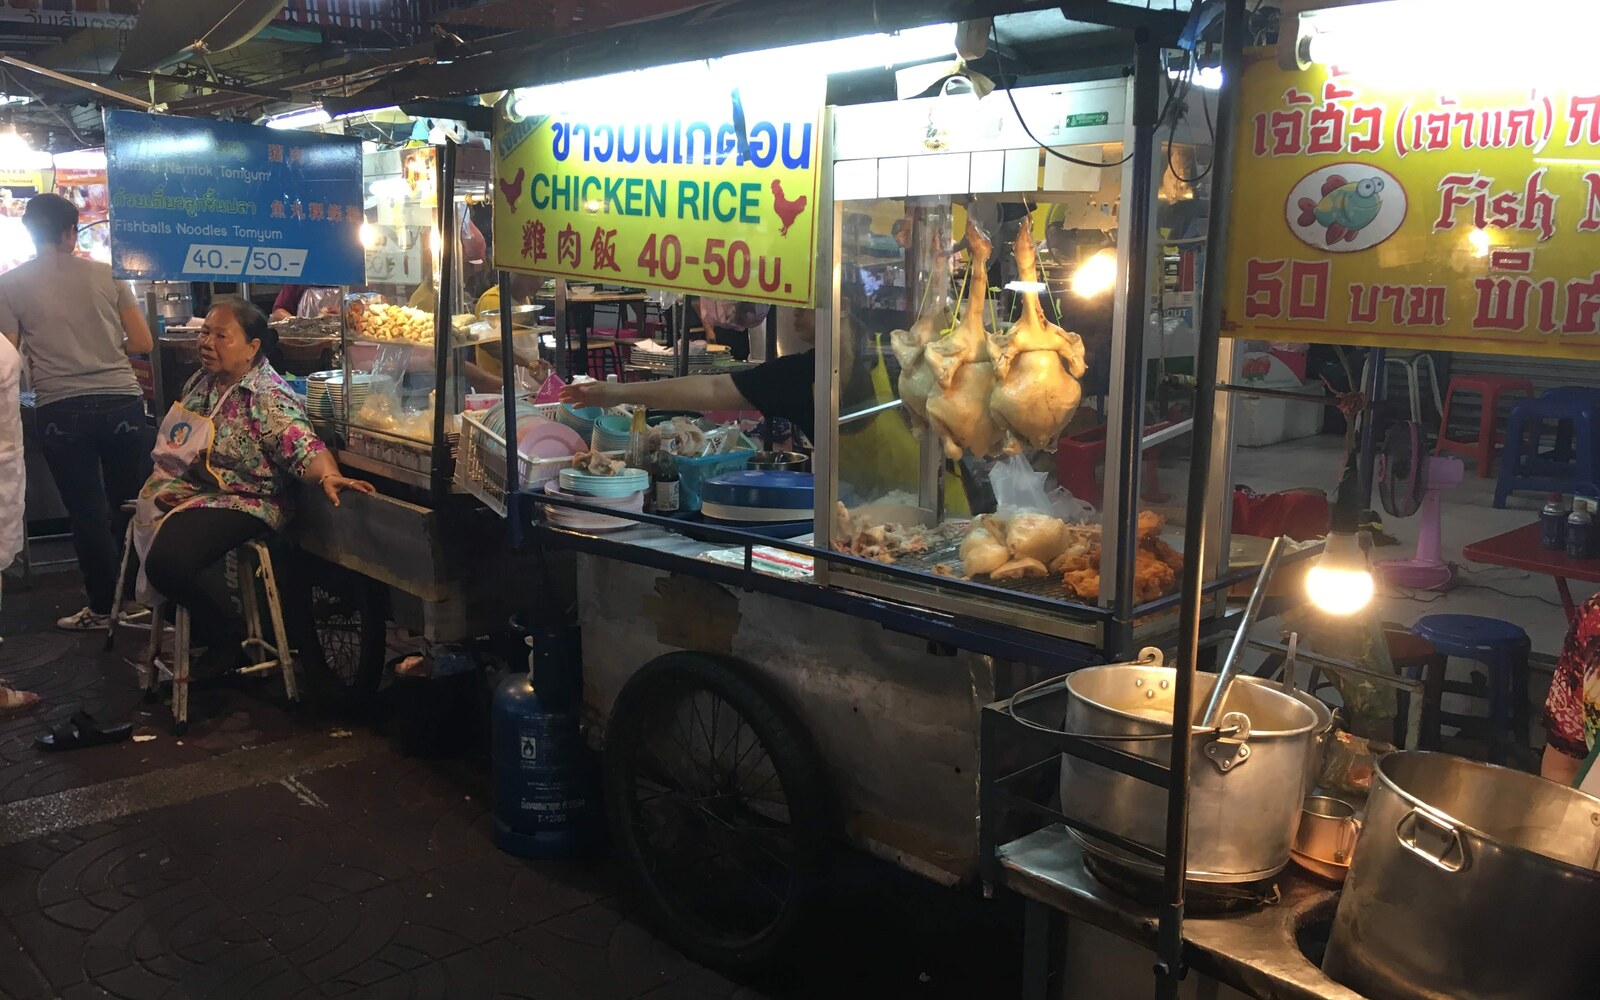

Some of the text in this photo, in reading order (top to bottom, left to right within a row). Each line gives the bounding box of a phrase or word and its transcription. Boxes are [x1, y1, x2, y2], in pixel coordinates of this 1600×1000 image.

[166, 162, 212, 177] Namtok
[219, 166, 270, 183] Tomyum
[530, 173, 762, 224] CHICKEN RICE
[1434, 167, 1559, 241] Fish
[114, 219, 283, 242] Fishballs Noodles Tomyum
[1244, 258, 1330, 320] 50
[1349, 283, 1449, 326] บาท
